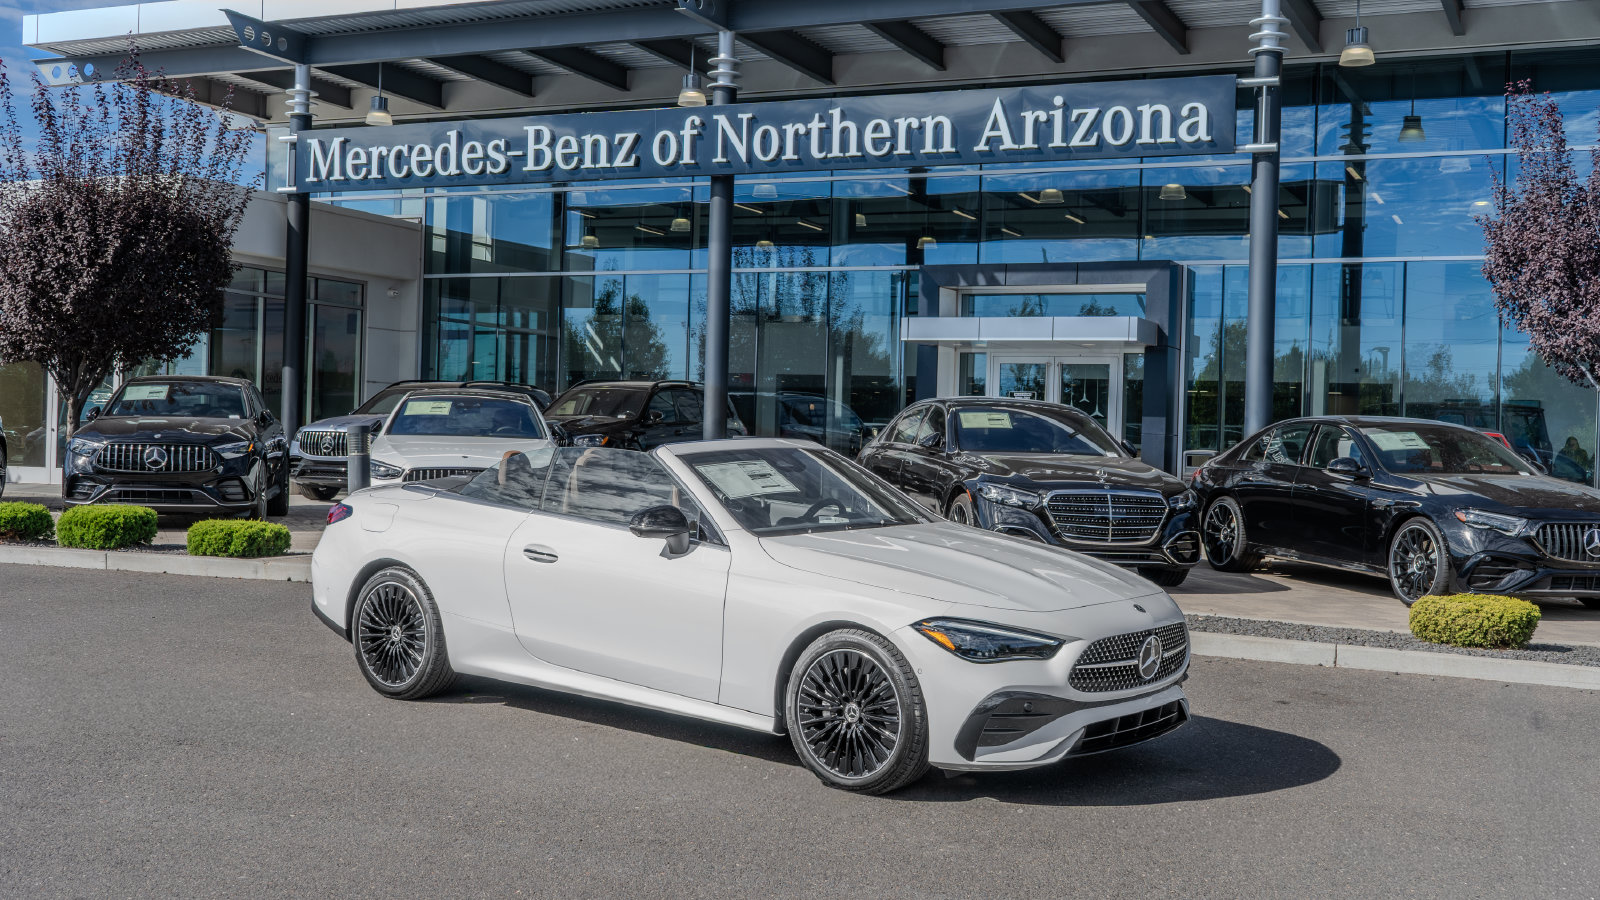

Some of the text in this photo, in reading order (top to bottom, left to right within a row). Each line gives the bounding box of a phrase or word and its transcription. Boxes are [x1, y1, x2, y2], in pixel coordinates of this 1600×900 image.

[305, 95, 1212, 182] Mercedes-Benz of Northern Arizona
